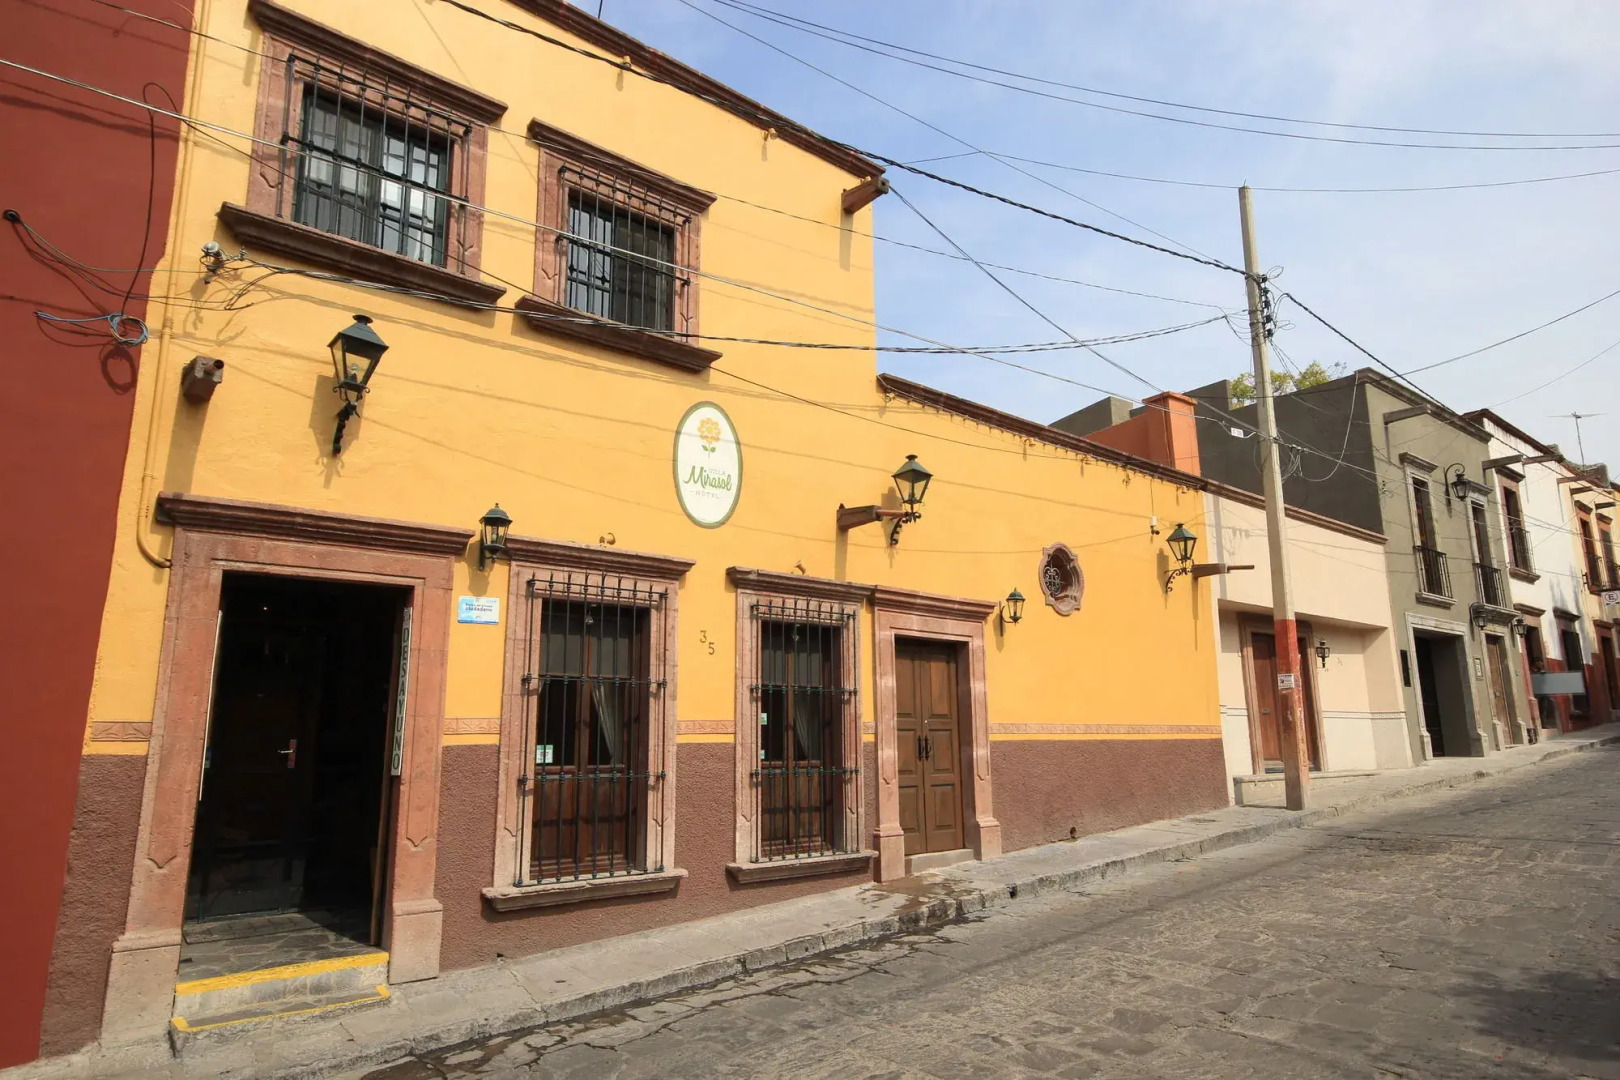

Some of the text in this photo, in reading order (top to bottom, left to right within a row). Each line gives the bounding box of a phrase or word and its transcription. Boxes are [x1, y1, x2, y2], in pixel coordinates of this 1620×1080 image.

[682, 465, 733, 491] Mirasol
[695, 490, 720, 499] HOTEL
[393, 628, 409, 769] DESAYUNO
